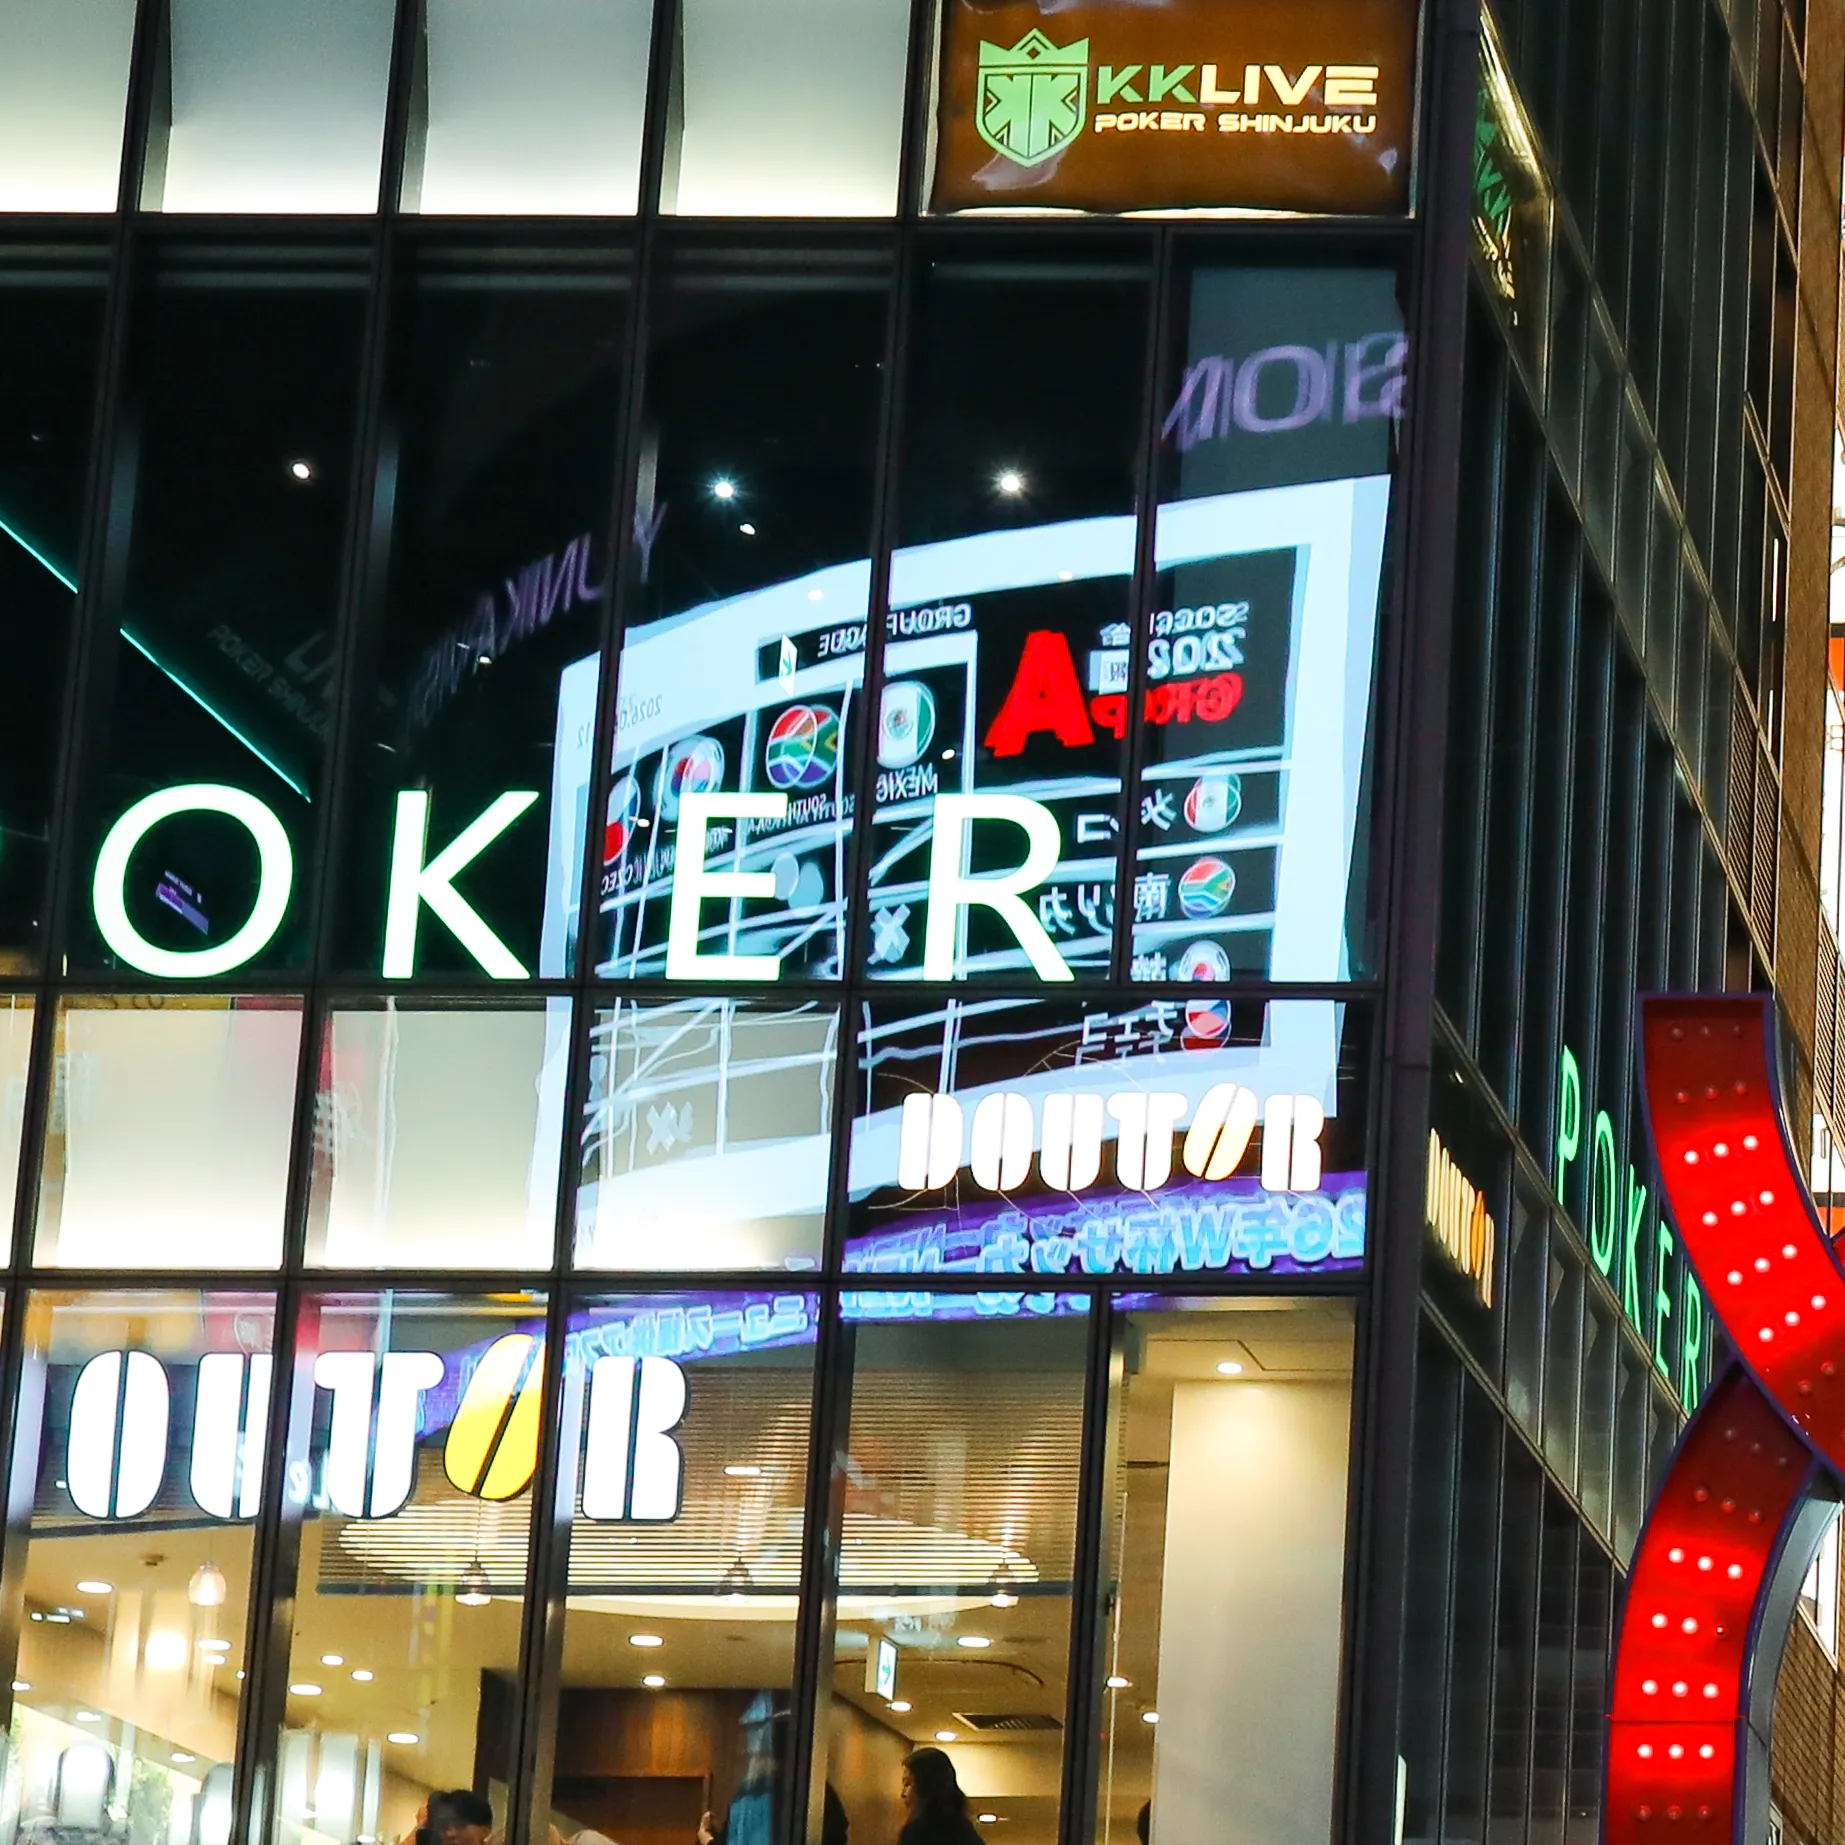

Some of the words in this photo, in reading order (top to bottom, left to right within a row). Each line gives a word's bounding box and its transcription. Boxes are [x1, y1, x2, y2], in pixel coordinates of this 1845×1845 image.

[1097, 63, 1380, 105] KKLIVE
[1094, 111, 1206, 133] POKER
[1217, 111, 1377, 135] SHINJUKU
[896, 1081, 1325, 1193] DOUTOR
[1556, 1042, 1703, 1418] POKER
